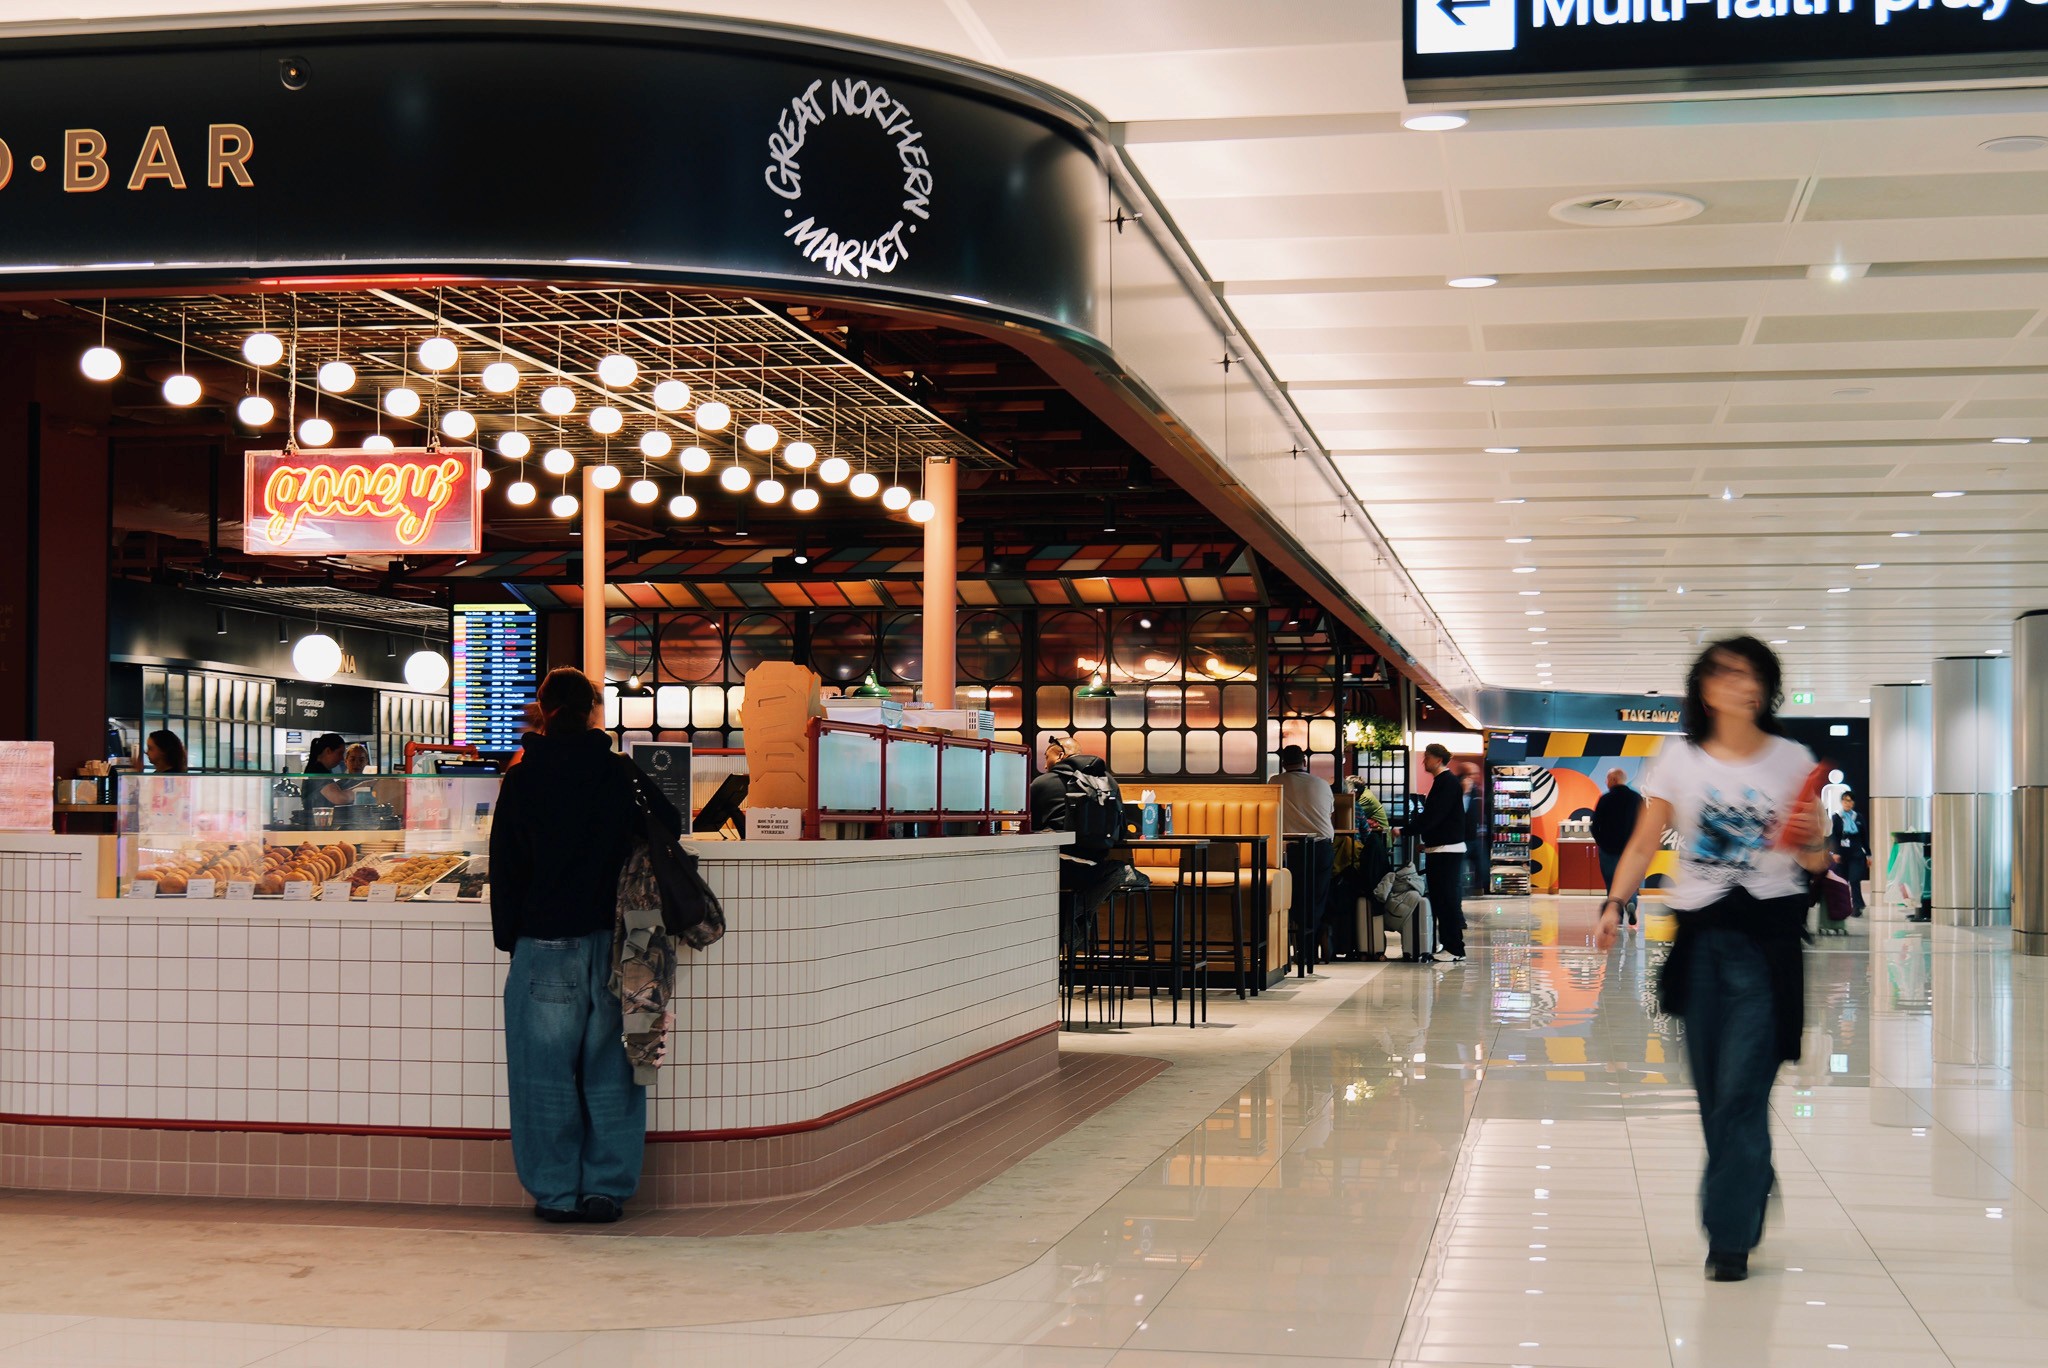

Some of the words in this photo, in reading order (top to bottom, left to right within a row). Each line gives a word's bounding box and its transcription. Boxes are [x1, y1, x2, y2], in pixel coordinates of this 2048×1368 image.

[765, 78, 826, 200] GREAT
[831, 77, 933, 220] NORTHERN
[783, 216, 909, 280] MARKET
[264, 457, 464, 546] gooey
[1619, 708, 1681, 723] TAKEAWAY
